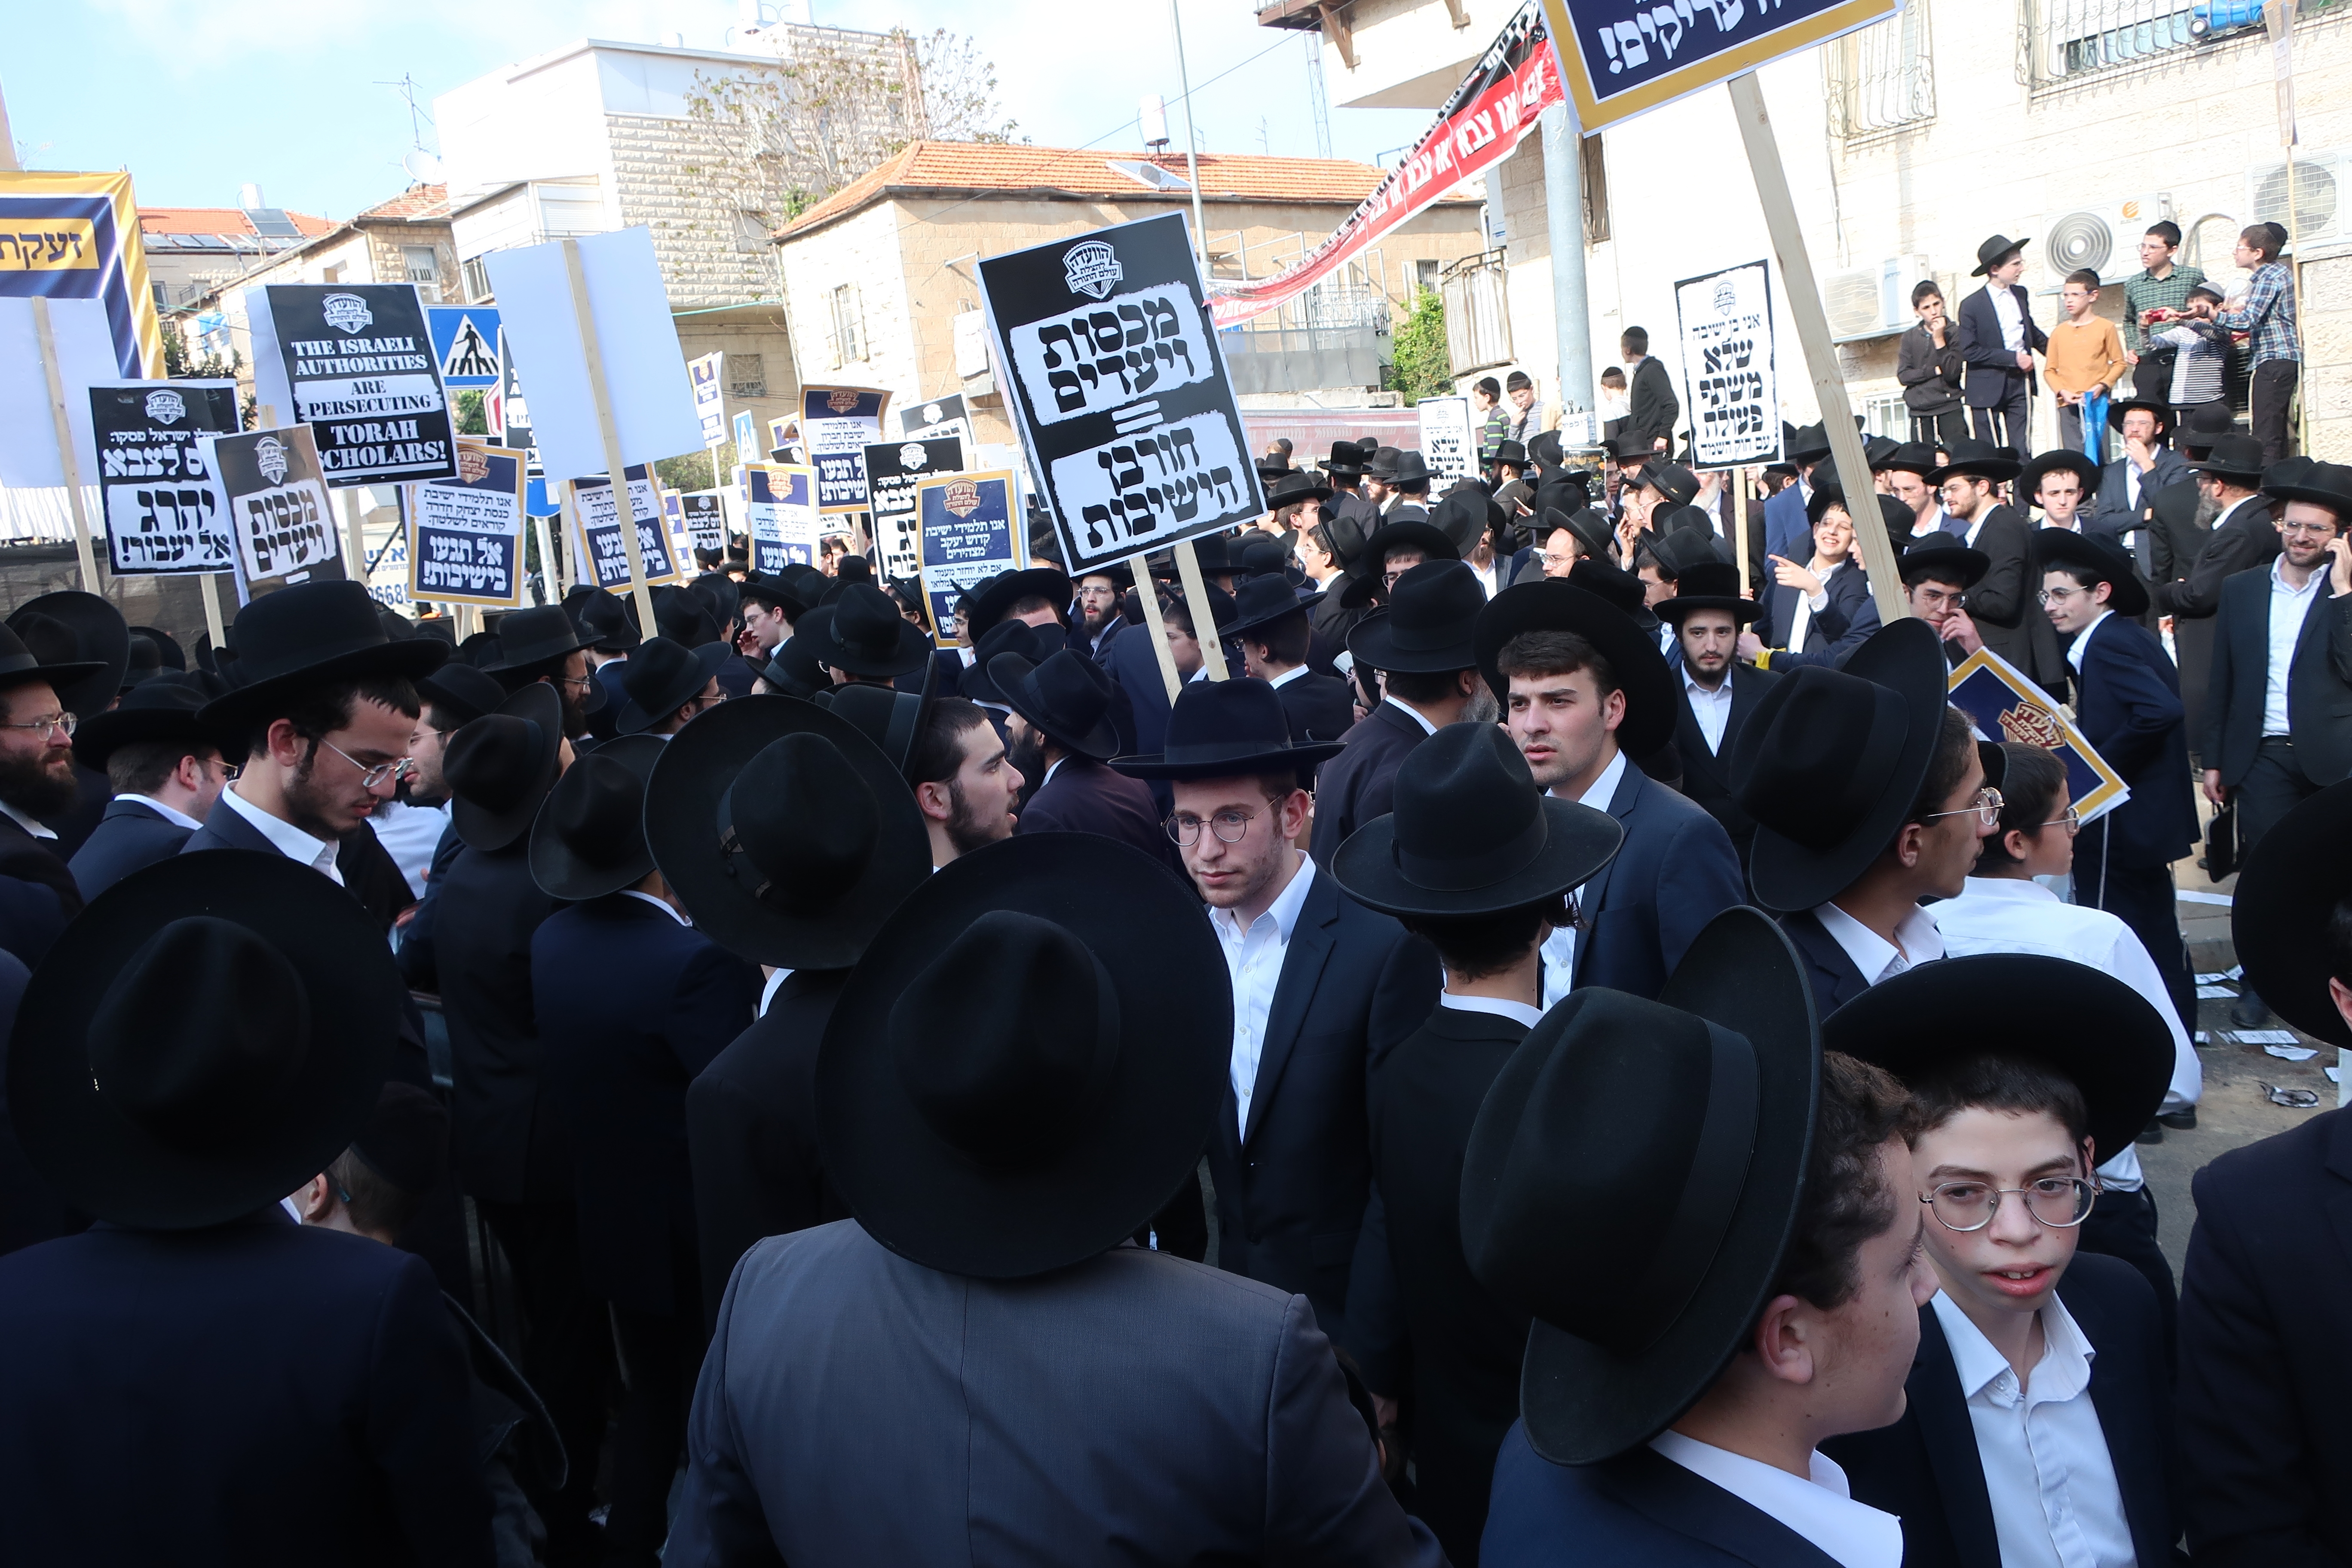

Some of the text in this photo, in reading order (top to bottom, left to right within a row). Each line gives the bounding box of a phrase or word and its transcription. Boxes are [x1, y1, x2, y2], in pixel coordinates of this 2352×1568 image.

[1455, 109, 1498, 159] צבא
[1406, 151, 1433, 194] צבא
[0, 232, 82, 270] זעקת
[1069, 246, 1109, 267] הוועדה
[1072, 268, 1117, 286] עולם התורה
[1080, 261, 1105, 274] להצלת
[1038, 297, 1180, 369] מכסות
[1692, 313, 1761, 341] אני בן ישיבה
[291, 337, 416, 357] THE ISRAELI
[1703, 337, 1753, 374] שלא
[295, 355, 428, 376] AUTHORITIES
[1048, 339, 1195, 413] ויעדים
[351, 380, 386, 395] ARE
[1700, 371, 1762, 408] משתף
[308, 395, 430, 417] PERSECUTING
[822, 420, 848, 429] תלמידי
[1704, 404, 1763, 438] פעולה
[110, 431, 146, 445] פסקו:
[149, 427, 190, 441] ישראל
[331, 420, 419, 445] TORAH
[821, 432, 841, 442] חברון
[817, 440, 845, 452] לשלטון:
[1432, 436, 1459, 453] שלא
[1701, 435, 1770, 459] עם חוק השמד
[103, 444, 180, 477] לצבא
[821, 459, 853, 481] תגעו
[1097, 427, 1200, 497] חורבן
[634, 484, 647, 493] אנו
[820, 479, 865, 502] שיבות!
[877, 475, 901, 488] פסקו:
[947, 482, 974, 495] הוועדה
[424, 489, 511, 507] אנו תלמידי ישיבת
[582, 491, 603, 502] ישיבת
[1082, 466, 1237, 548] הישיבות
[138, 488, 214, 532] יהרג
[248, 489, 318, 535] מכסות
[426, 502, 509, 518] כנסת יצחק חדרה
[428, 514, 505, 533] קוראים לשלטון:
[756, 518, 774, 526] מרדכי
[925, 518, 1005, 537] אנו תלמידי ישיבת
[121, 530, 230, 562] אל יעבור!
[253, 523, 326, 573] ויעדים
[430, 535, 503, 566] אל תגעו
[940, 533, 990, 551] קדוש יעקב
[946, 547, 985, 559] מצהירים
[423, 560, 507, 591] בישיבות!
[598, 549, 665, 581] ביבות!
[934, 569, 955, 577] מעמד
[957, 567, 975, 575] יוחזר
[977, 563, 988, 573] לא
